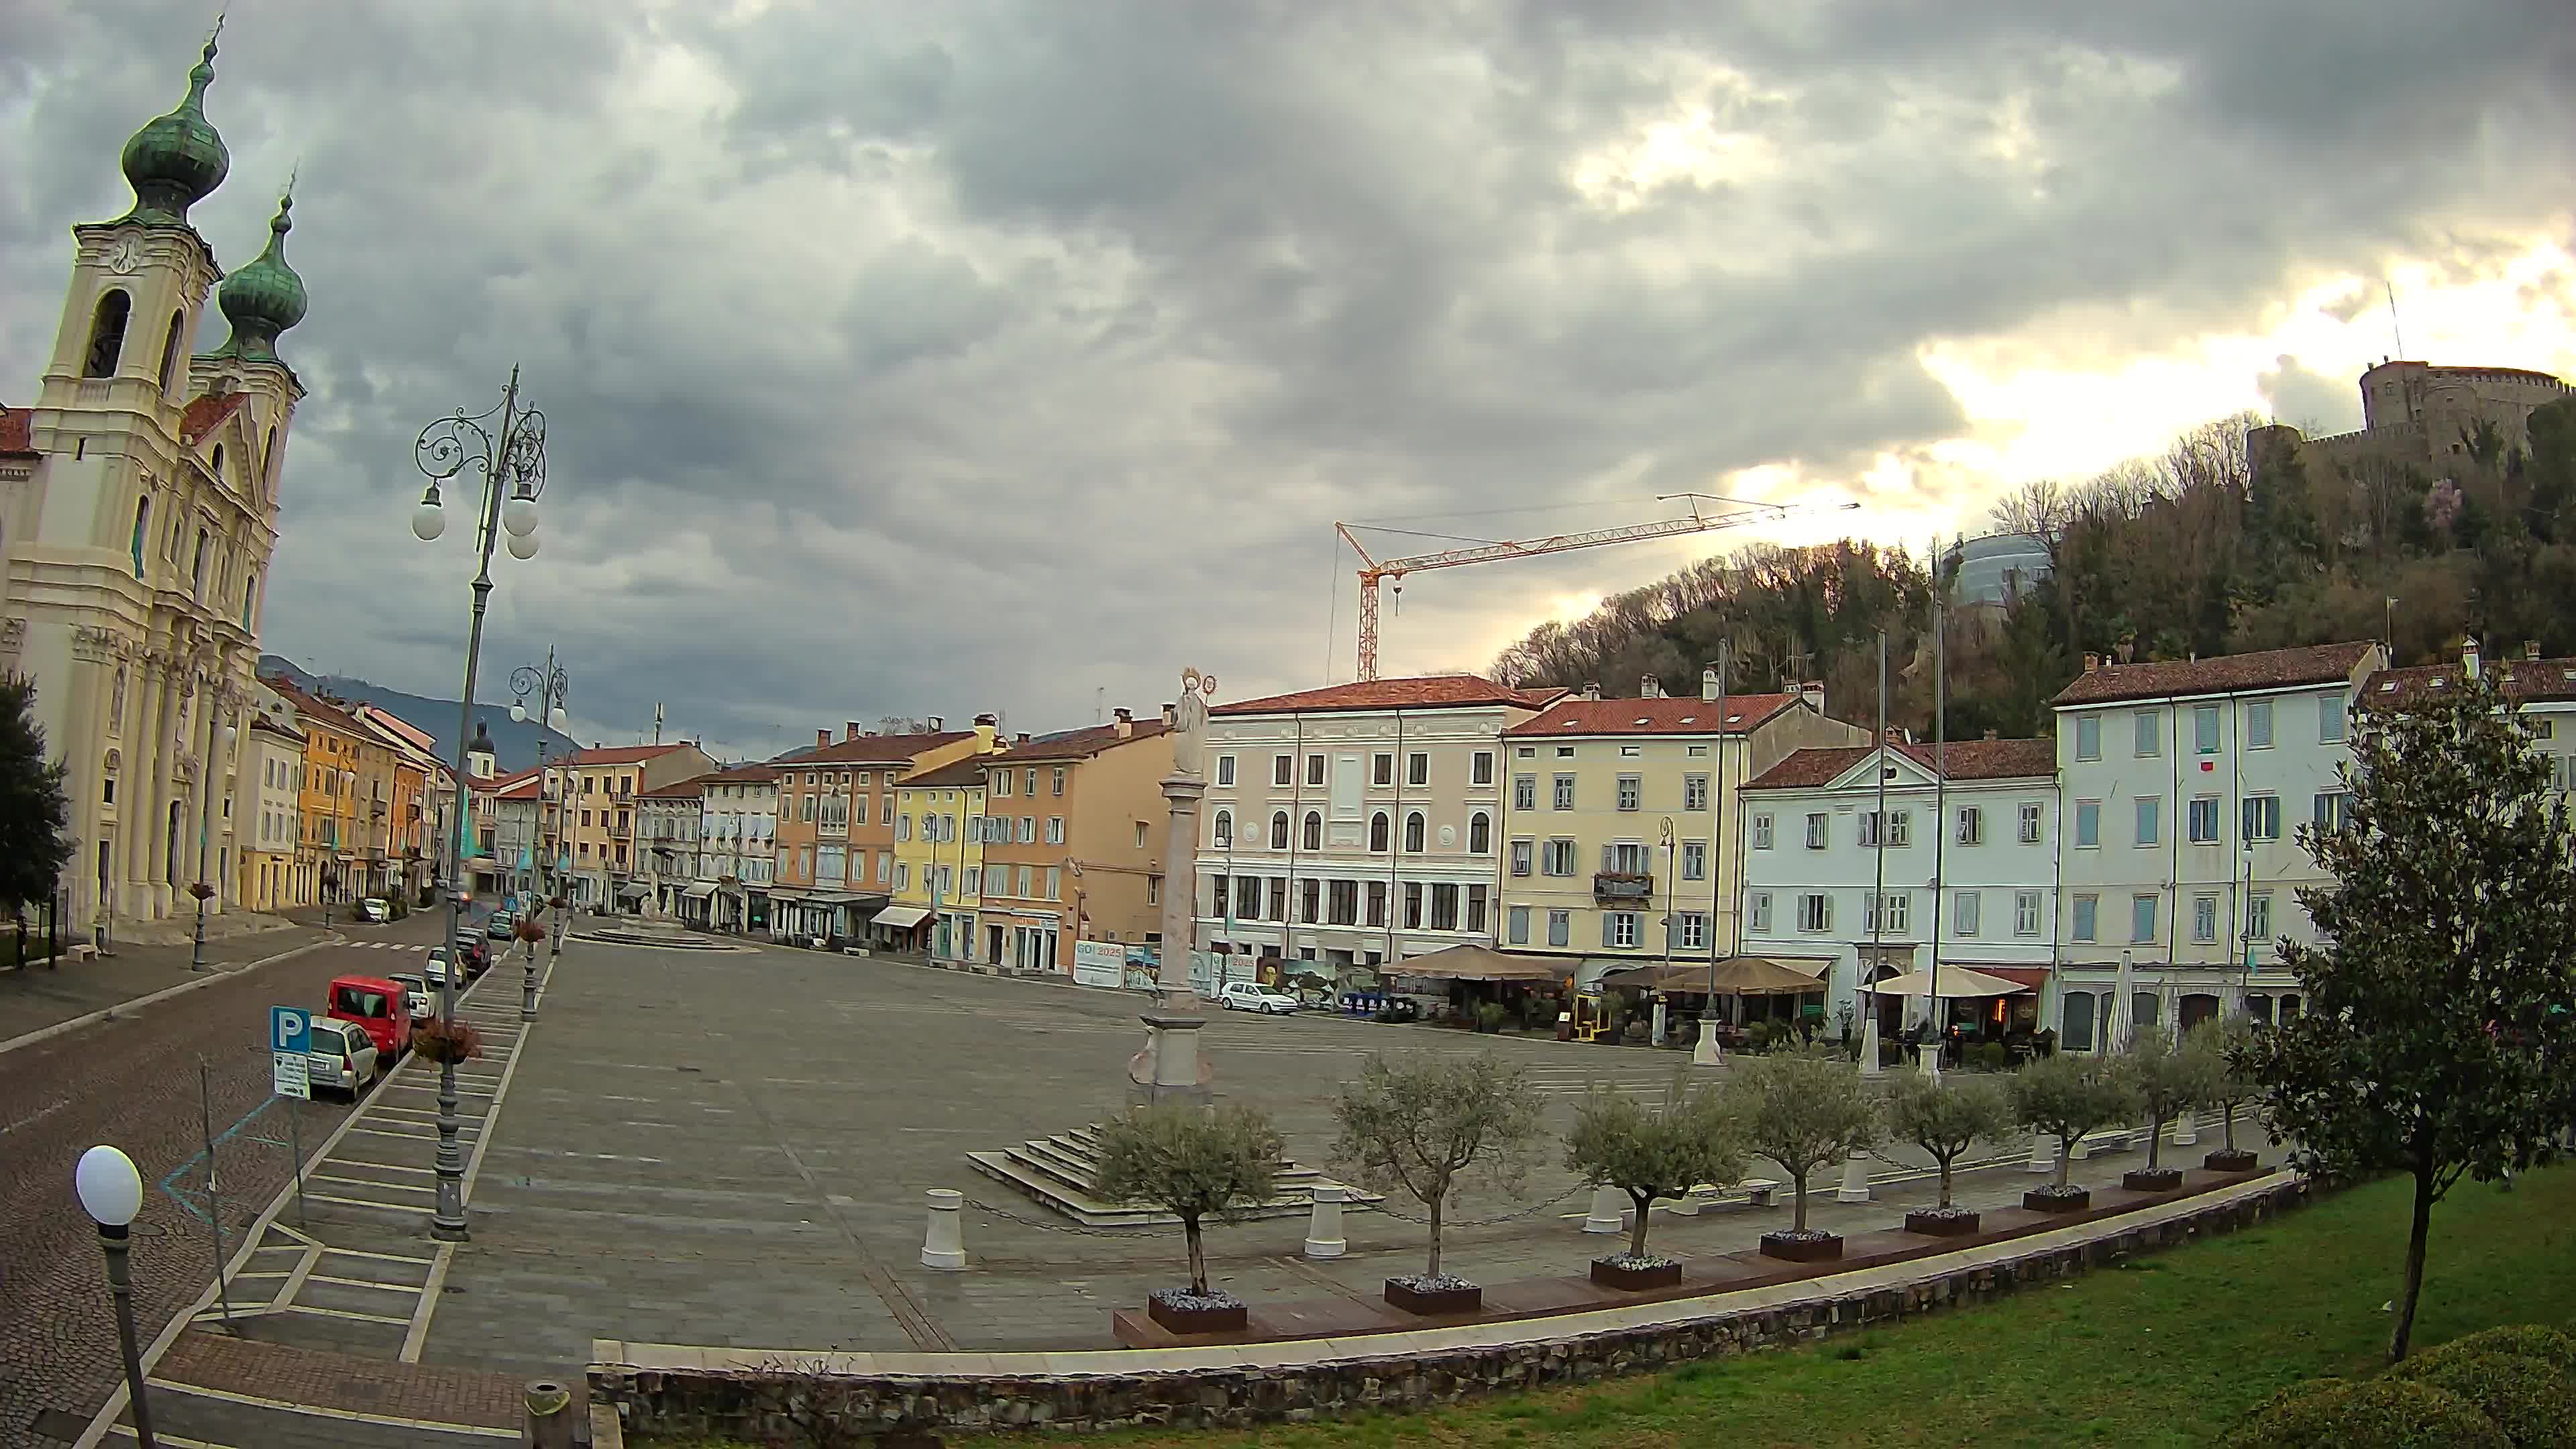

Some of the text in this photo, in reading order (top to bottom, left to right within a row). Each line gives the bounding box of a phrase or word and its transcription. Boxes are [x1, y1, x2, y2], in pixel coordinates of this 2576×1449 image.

[1077, 944, 1121, 957] GO! 2025
[279, 1012, 303, 1046] P
